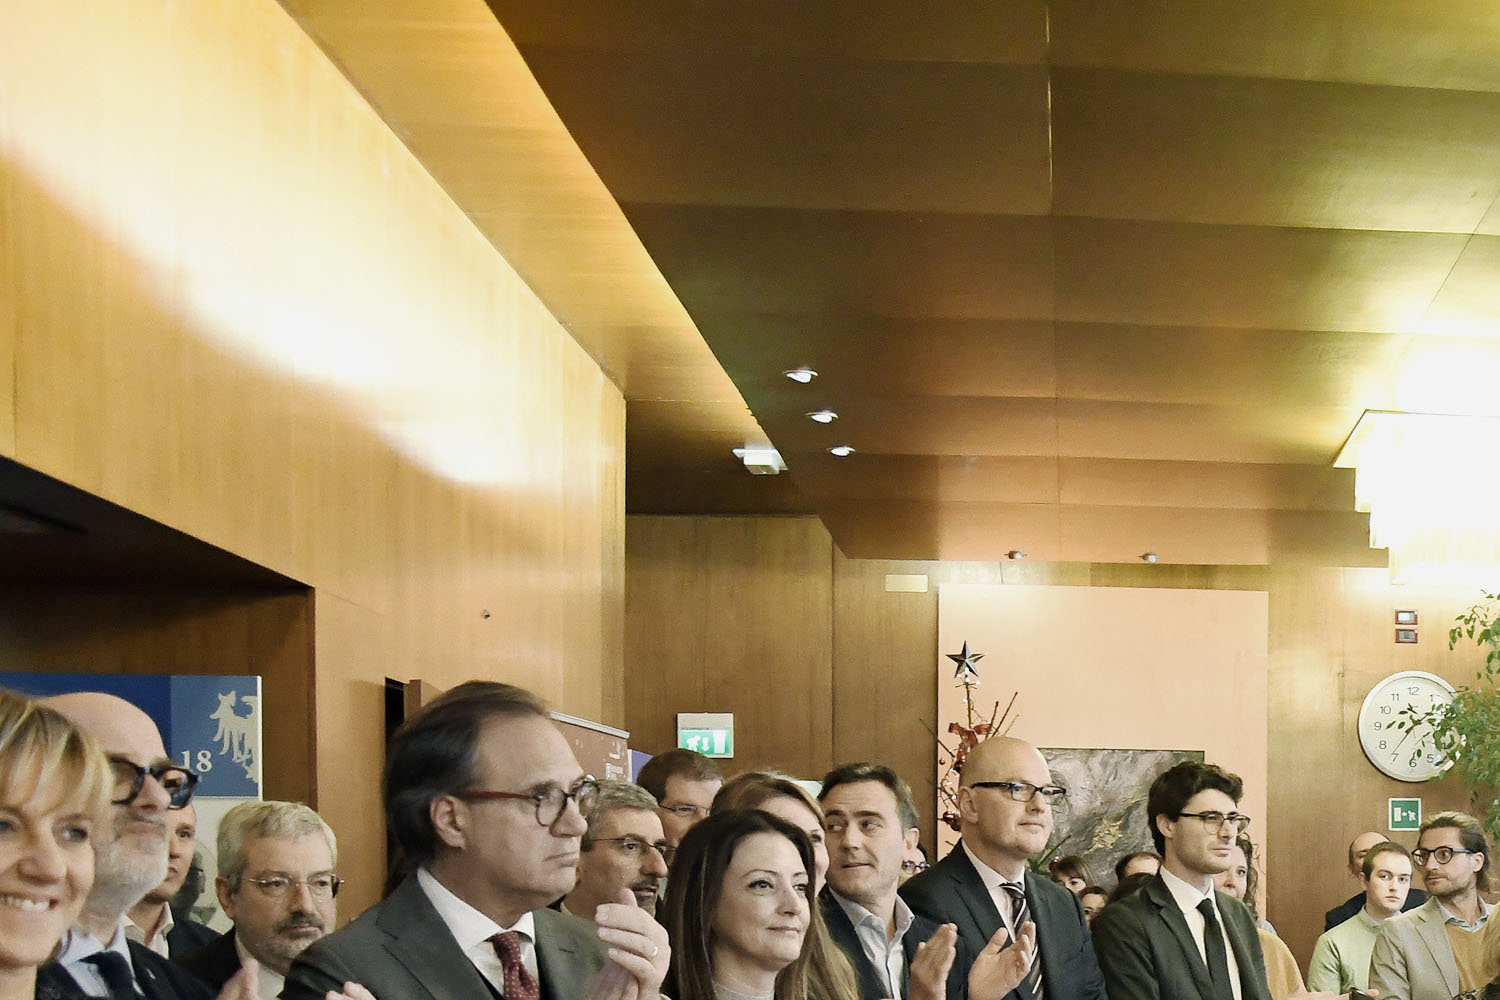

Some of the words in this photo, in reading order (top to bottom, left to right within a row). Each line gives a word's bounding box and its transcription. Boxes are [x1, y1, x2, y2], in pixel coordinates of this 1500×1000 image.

[1407, 686, 1420, 696] 12
[1390, 693, 1400, 702] 11
[1379, 705, 1392, 715] 10
[1373, 721, 1382, 731] 9
[1378, 739, 1388, 750] 8
[1391, 753, 1399, 762] 7
[1426, 753, 1435, 763] 5
[1408, 758, 1418, 768] 6
